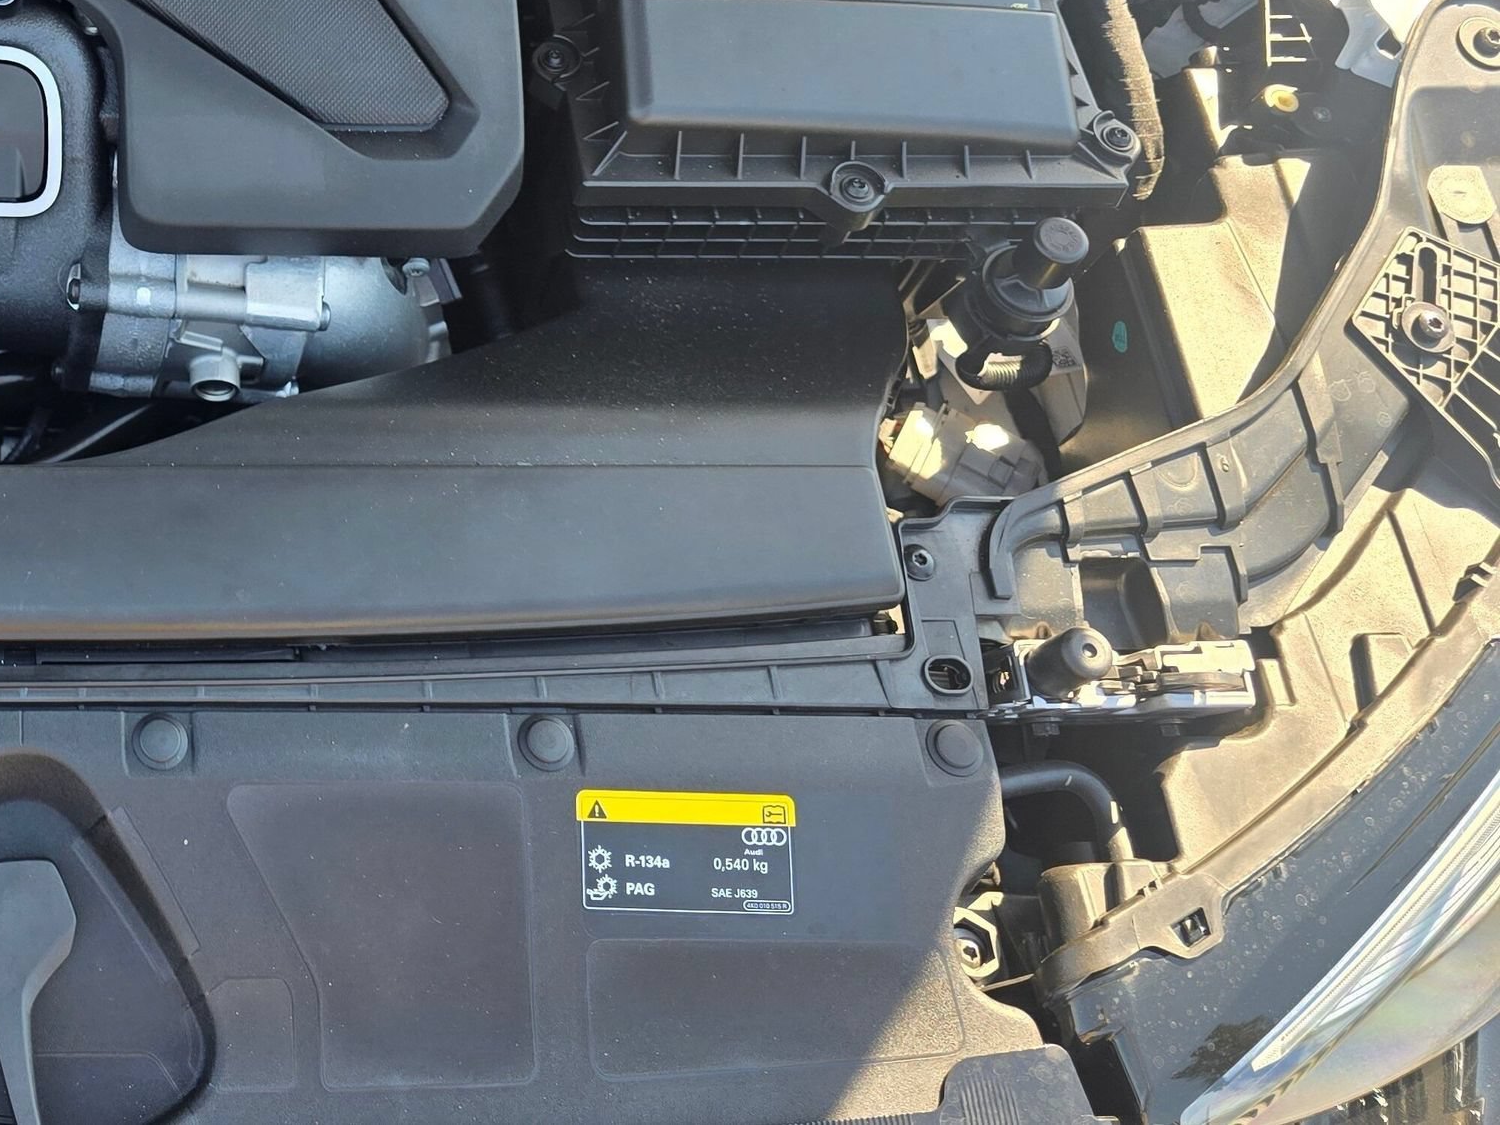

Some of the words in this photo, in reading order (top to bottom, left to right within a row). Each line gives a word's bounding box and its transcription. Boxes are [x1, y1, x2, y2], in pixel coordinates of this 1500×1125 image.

[744, 848, 764, 857] Audi
[624, 854, 671, 869] R-134a
[713, 857, 750, 872] 0,540
[753, 858, 768, 874] kg
[625, 882, 656, 896] PAG
[711, 888, 733, 898] SAE
[734, 888, 759, 899] J639
